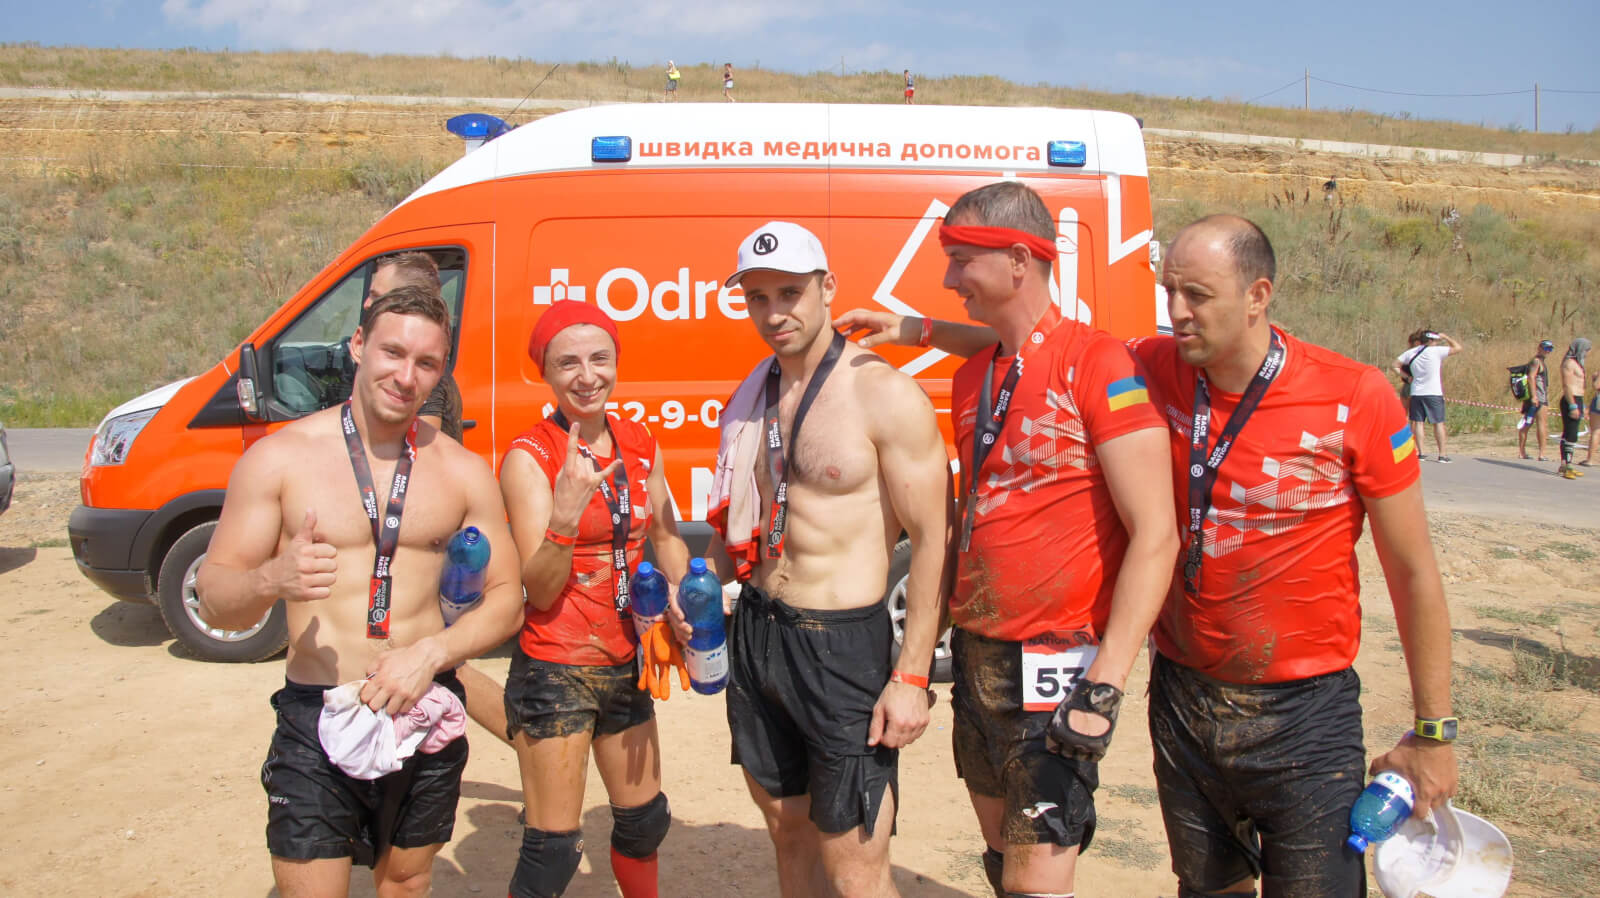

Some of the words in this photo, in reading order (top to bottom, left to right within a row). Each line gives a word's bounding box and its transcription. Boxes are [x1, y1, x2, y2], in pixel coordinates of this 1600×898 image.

[639, 141, 753, 160] швидка
[763, 141, 891, 160] медична
[900, 143, 1041, 161] допомога
[1258, 356, 1274, 377] RACE
[1263, 352, 1281, 380] NATION
[994, 389, 1006, 417] NATION
[1002, 391, 1011, 412] RACE
[772, 422, 782, 448] NATION
[1193, 413, 1202, 445] NATION
[1200, 415, 1208, 437] RACE
[1208, 446, 1221, 467] RACE
[1211, 441, 1230, 468] NATION
[391, 473, 402, 499] NATION
[399, 474, 407, 494] RACE
[1035, 667, 1085, 698] 53
